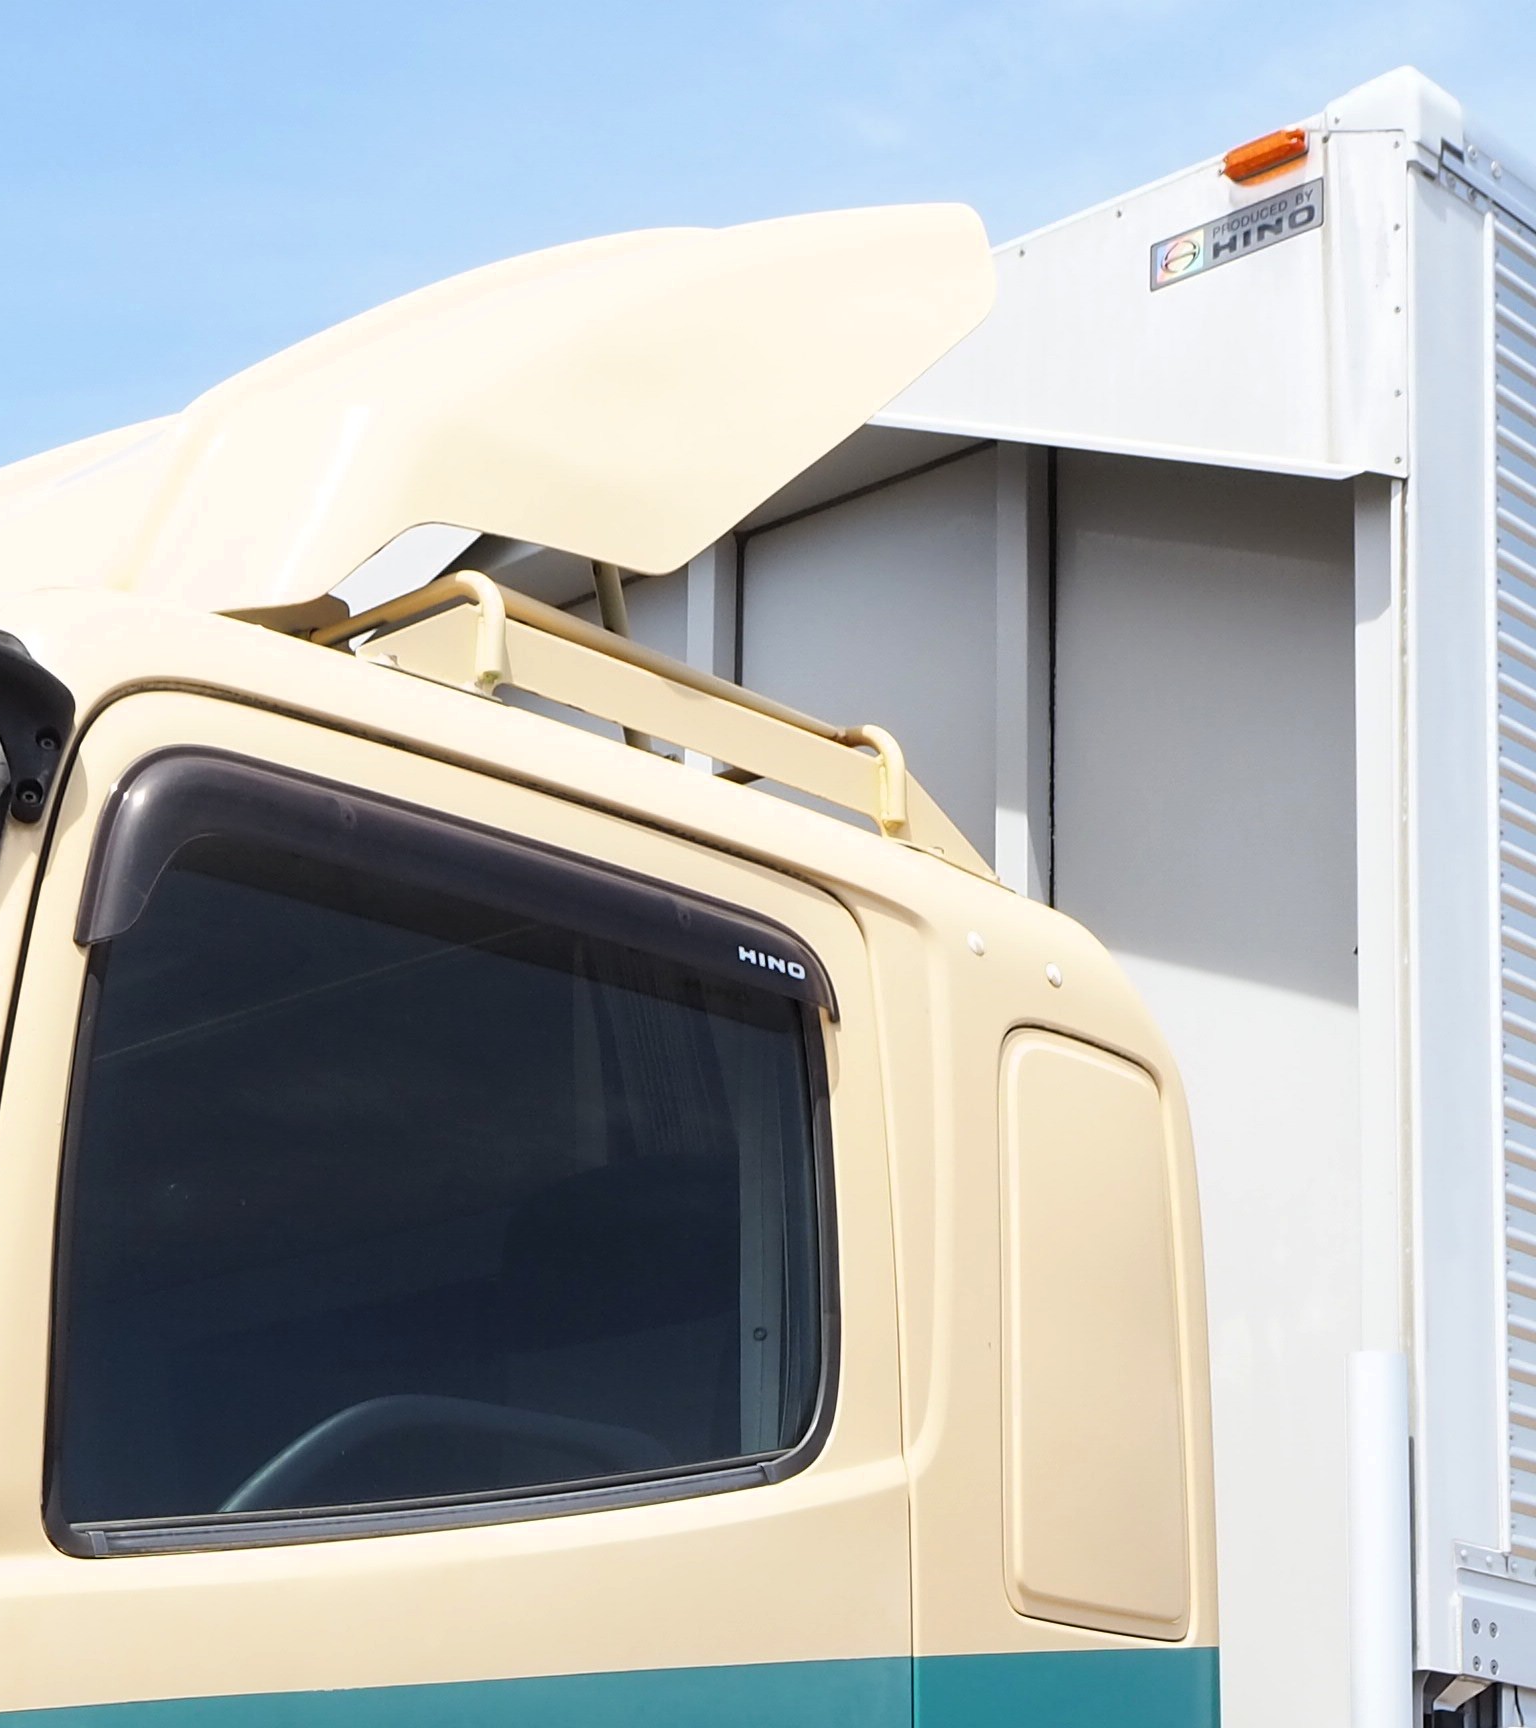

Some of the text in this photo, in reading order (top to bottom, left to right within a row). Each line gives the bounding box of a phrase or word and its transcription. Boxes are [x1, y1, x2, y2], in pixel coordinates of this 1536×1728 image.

[1212, 188, 1314, 240] PRODUCED BY
[1212, 204, 1315, 260] HINO
[738, 945, 806, 980] HINO
